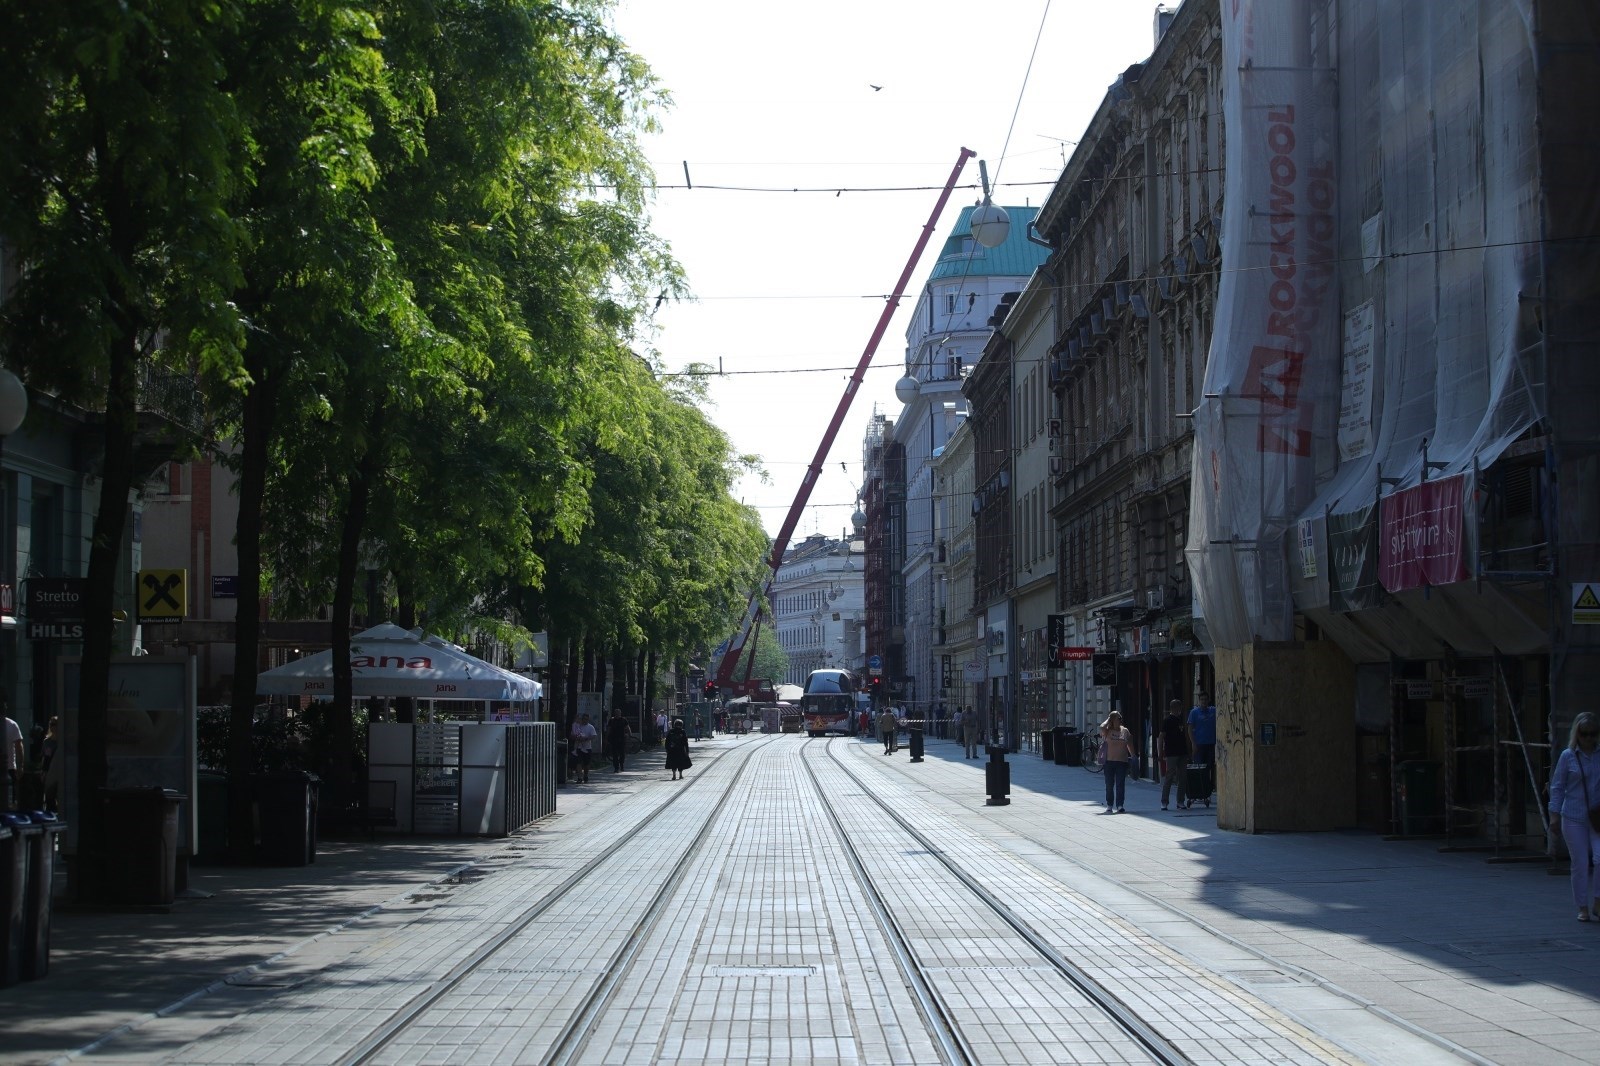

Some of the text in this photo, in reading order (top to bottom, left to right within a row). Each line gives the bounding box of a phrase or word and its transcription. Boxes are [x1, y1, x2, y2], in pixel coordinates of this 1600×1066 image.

[1266, 104, 1297, 338] ROCKWOOL
[36, 590, 79, 602] Stretto
[31, 624, 83, 638] HILLS
[1062, 650, 1087, 659] Triumph
[351, 655, 432, 669] ana
